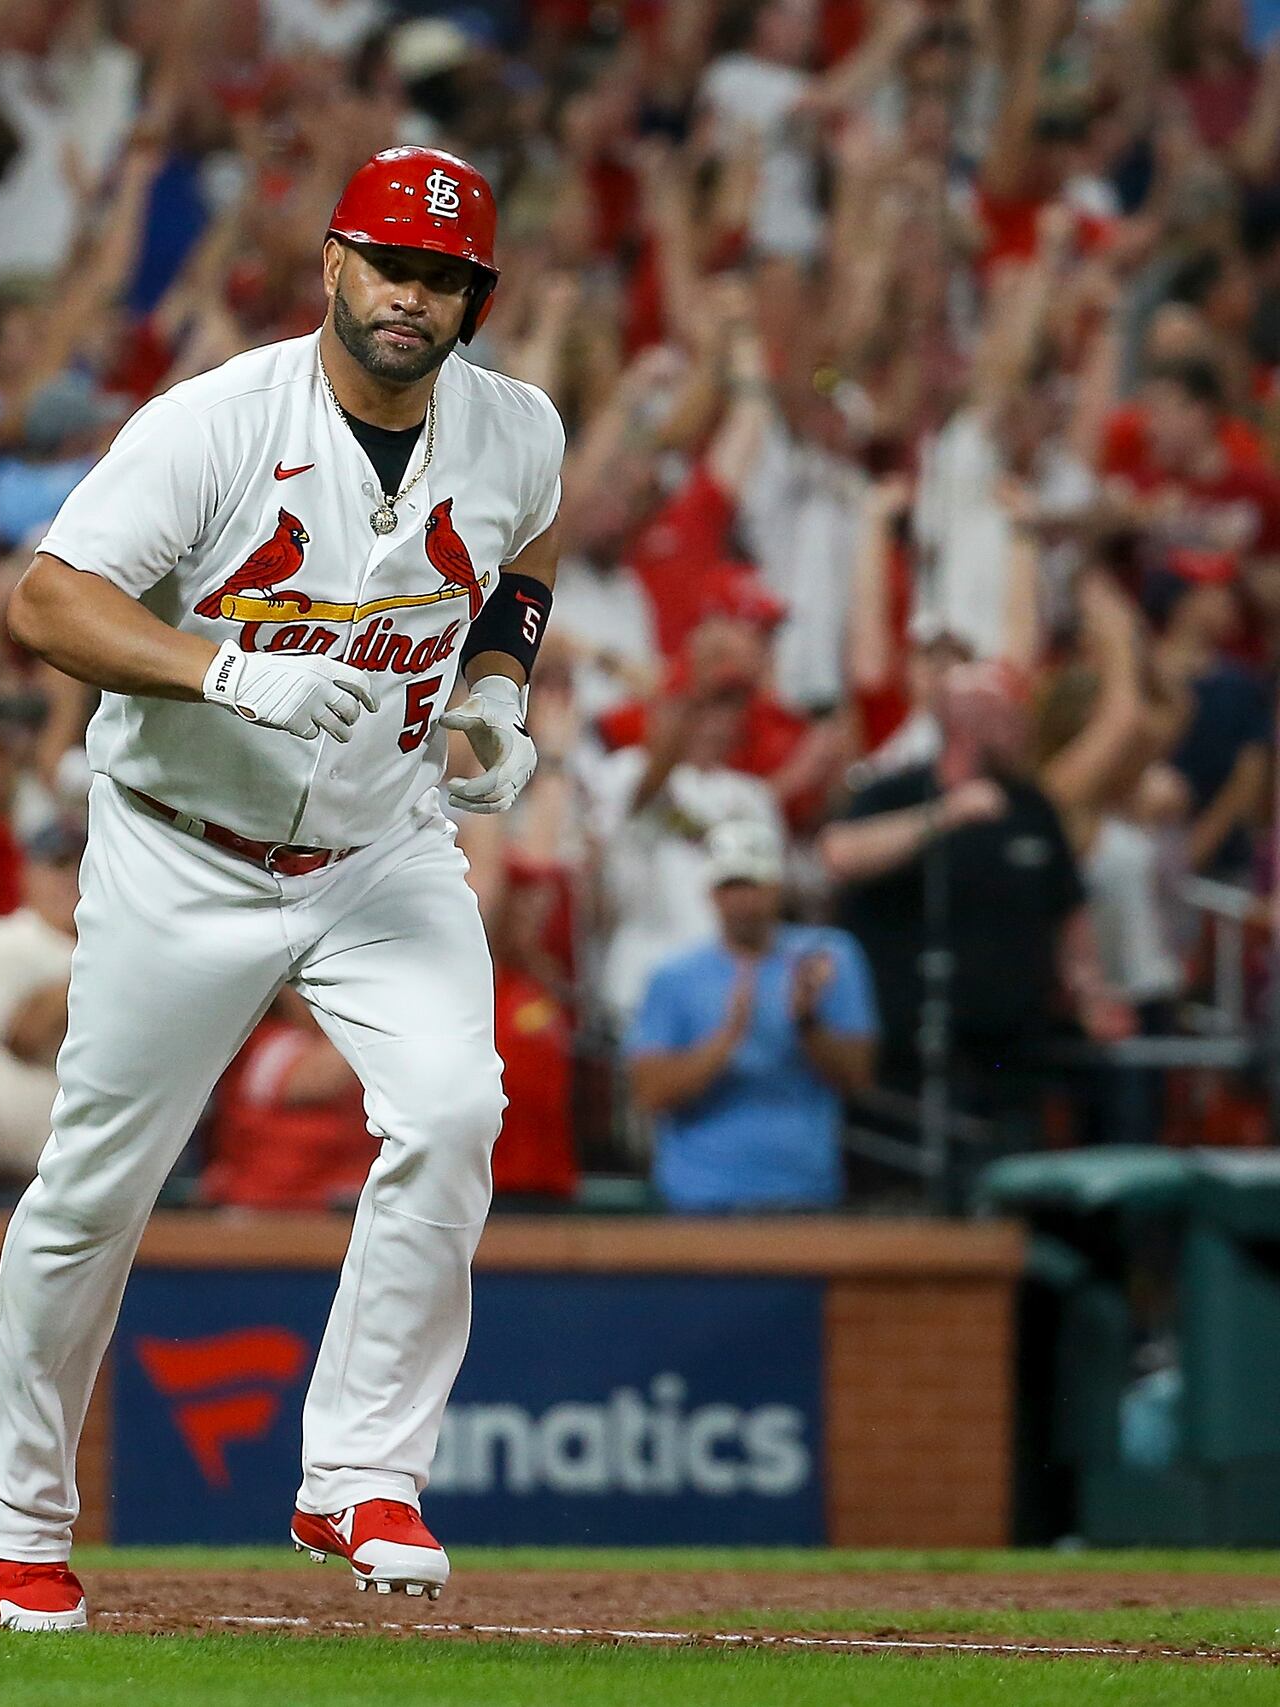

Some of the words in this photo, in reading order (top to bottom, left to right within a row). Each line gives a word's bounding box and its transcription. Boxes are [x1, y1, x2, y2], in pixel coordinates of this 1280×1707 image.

[522, 605, 541, 645] 5
[215, 654, 237, 693] PUJOLS
[397, 673, 444, 754] 5
